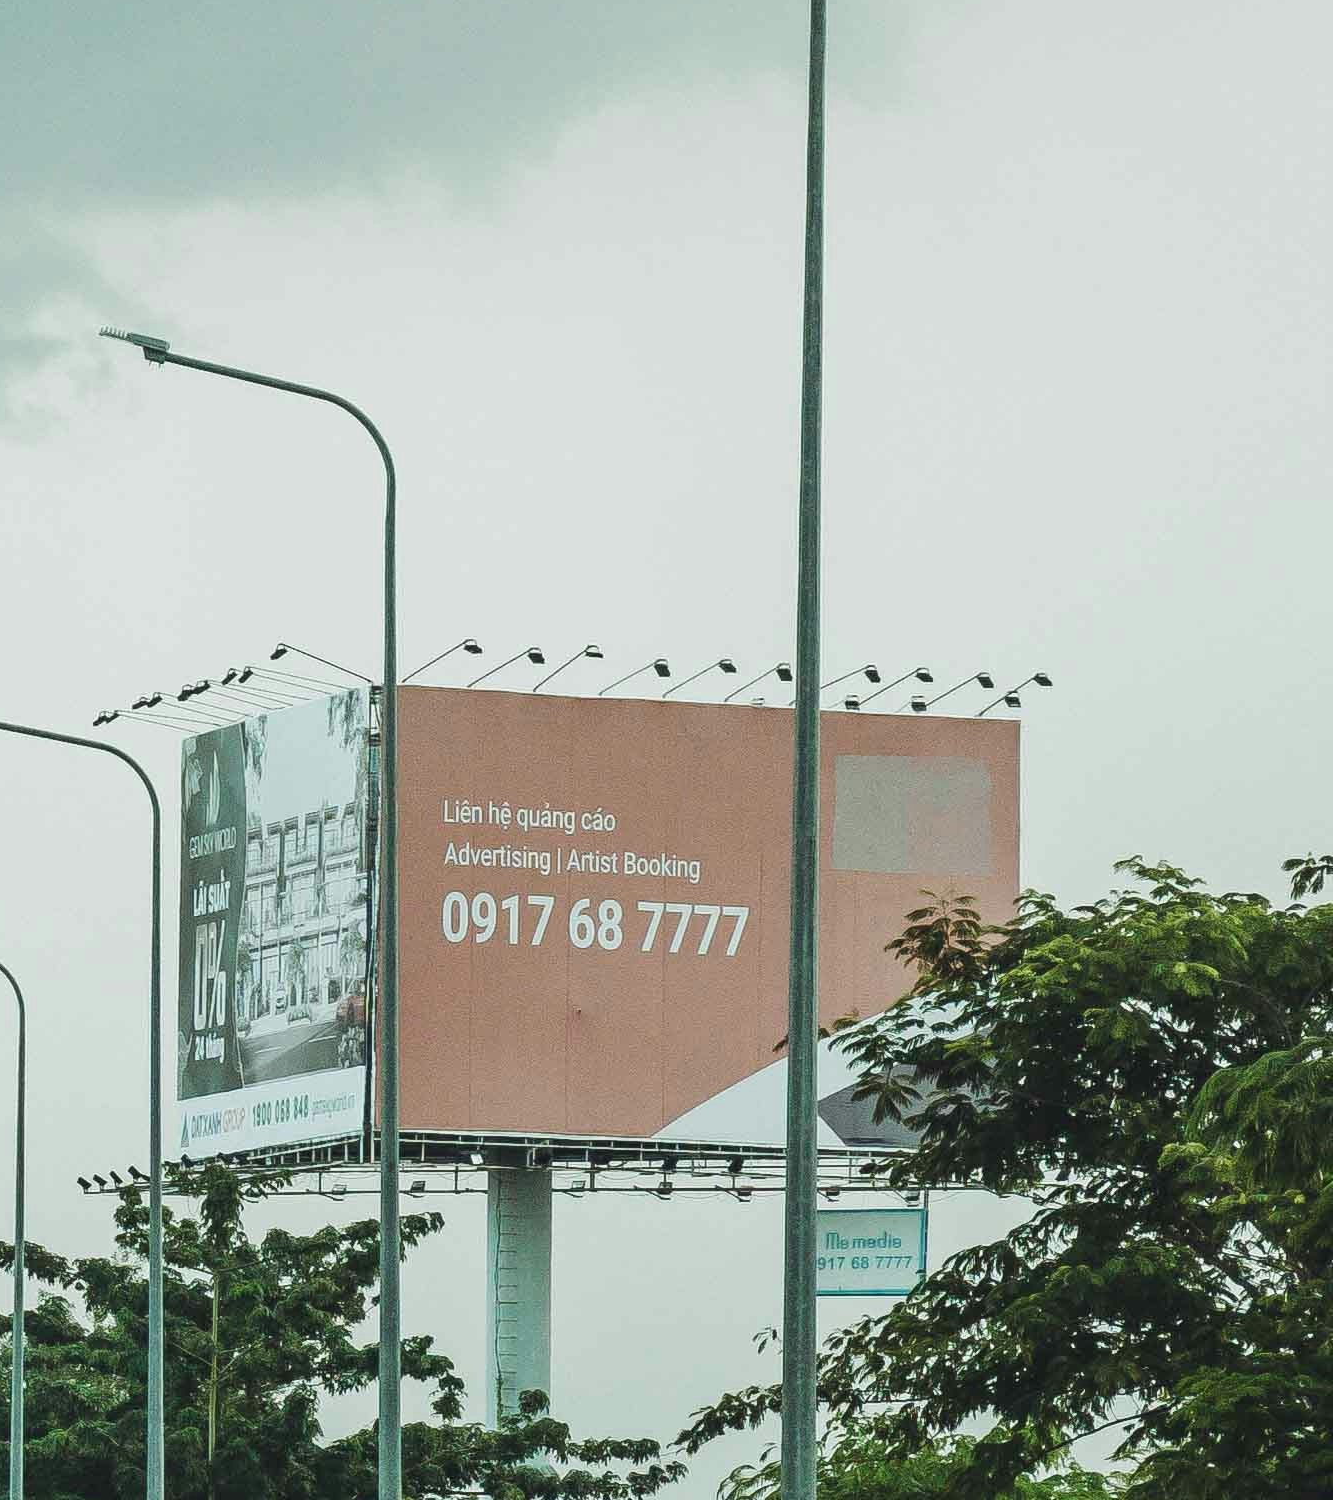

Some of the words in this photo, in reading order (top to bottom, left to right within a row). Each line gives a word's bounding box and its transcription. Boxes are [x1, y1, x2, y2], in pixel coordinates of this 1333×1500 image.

[442, 800, 483, 825] Liên
[488, 802, 512, 829] hệ
[517, 803, 576, 835] quảng
[581, 807, 616, 831] cáo
[444, 842, 551, 876] Advertising
[566, 849, 618, 874] Artist
[623, 852, 701, 884] Booking
[442, 891, 555, 946] 0917
[569, 898, 623, 951] 68
[637, 901, 750, 957] 7777
[194, 919, 227, 1032] 0%
[252, 1101, 271, 1128] 1900
[817, 1256, 846, 1270] 917
[851, 1256, 870, 1270] 68
[875, 1255, 913, 1269] 7777
